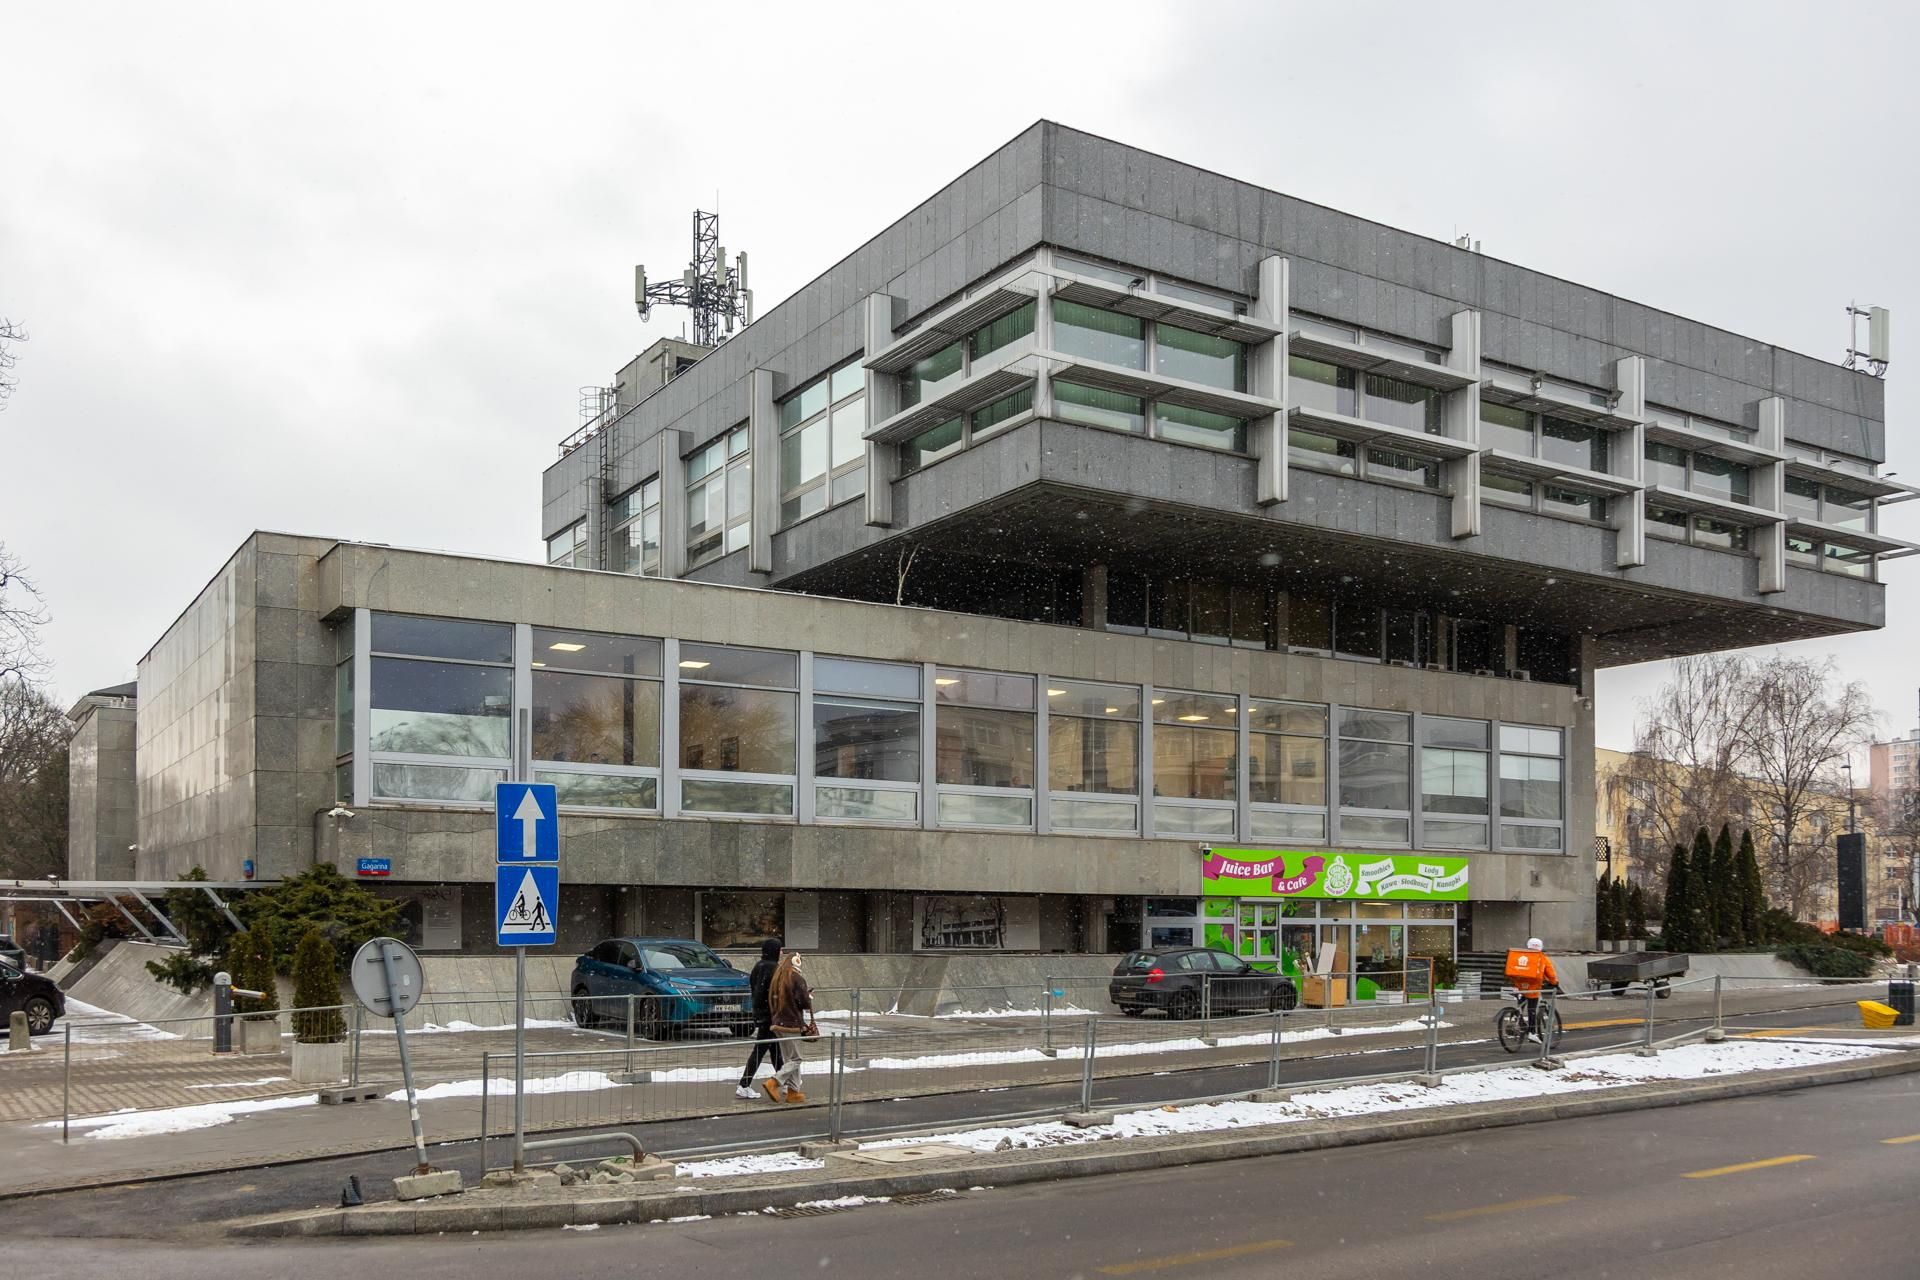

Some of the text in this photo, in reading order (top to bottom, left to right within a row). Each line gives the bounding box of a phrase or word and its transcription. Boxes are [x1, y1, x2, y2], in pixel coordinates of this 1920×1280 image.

[361, 862, 388, 872] Gagarina
[1220, 861, 1275, 876] Juice Bar
[1361, 864, 1391, 877] Smoothies
[1424, 866, 1439, 875] Lody
[1278, 877, 1308, 891] & Cafe
[1380, 880, 1398, 891] Kawa
[1436, 876, 1462, 888] Kanapki
